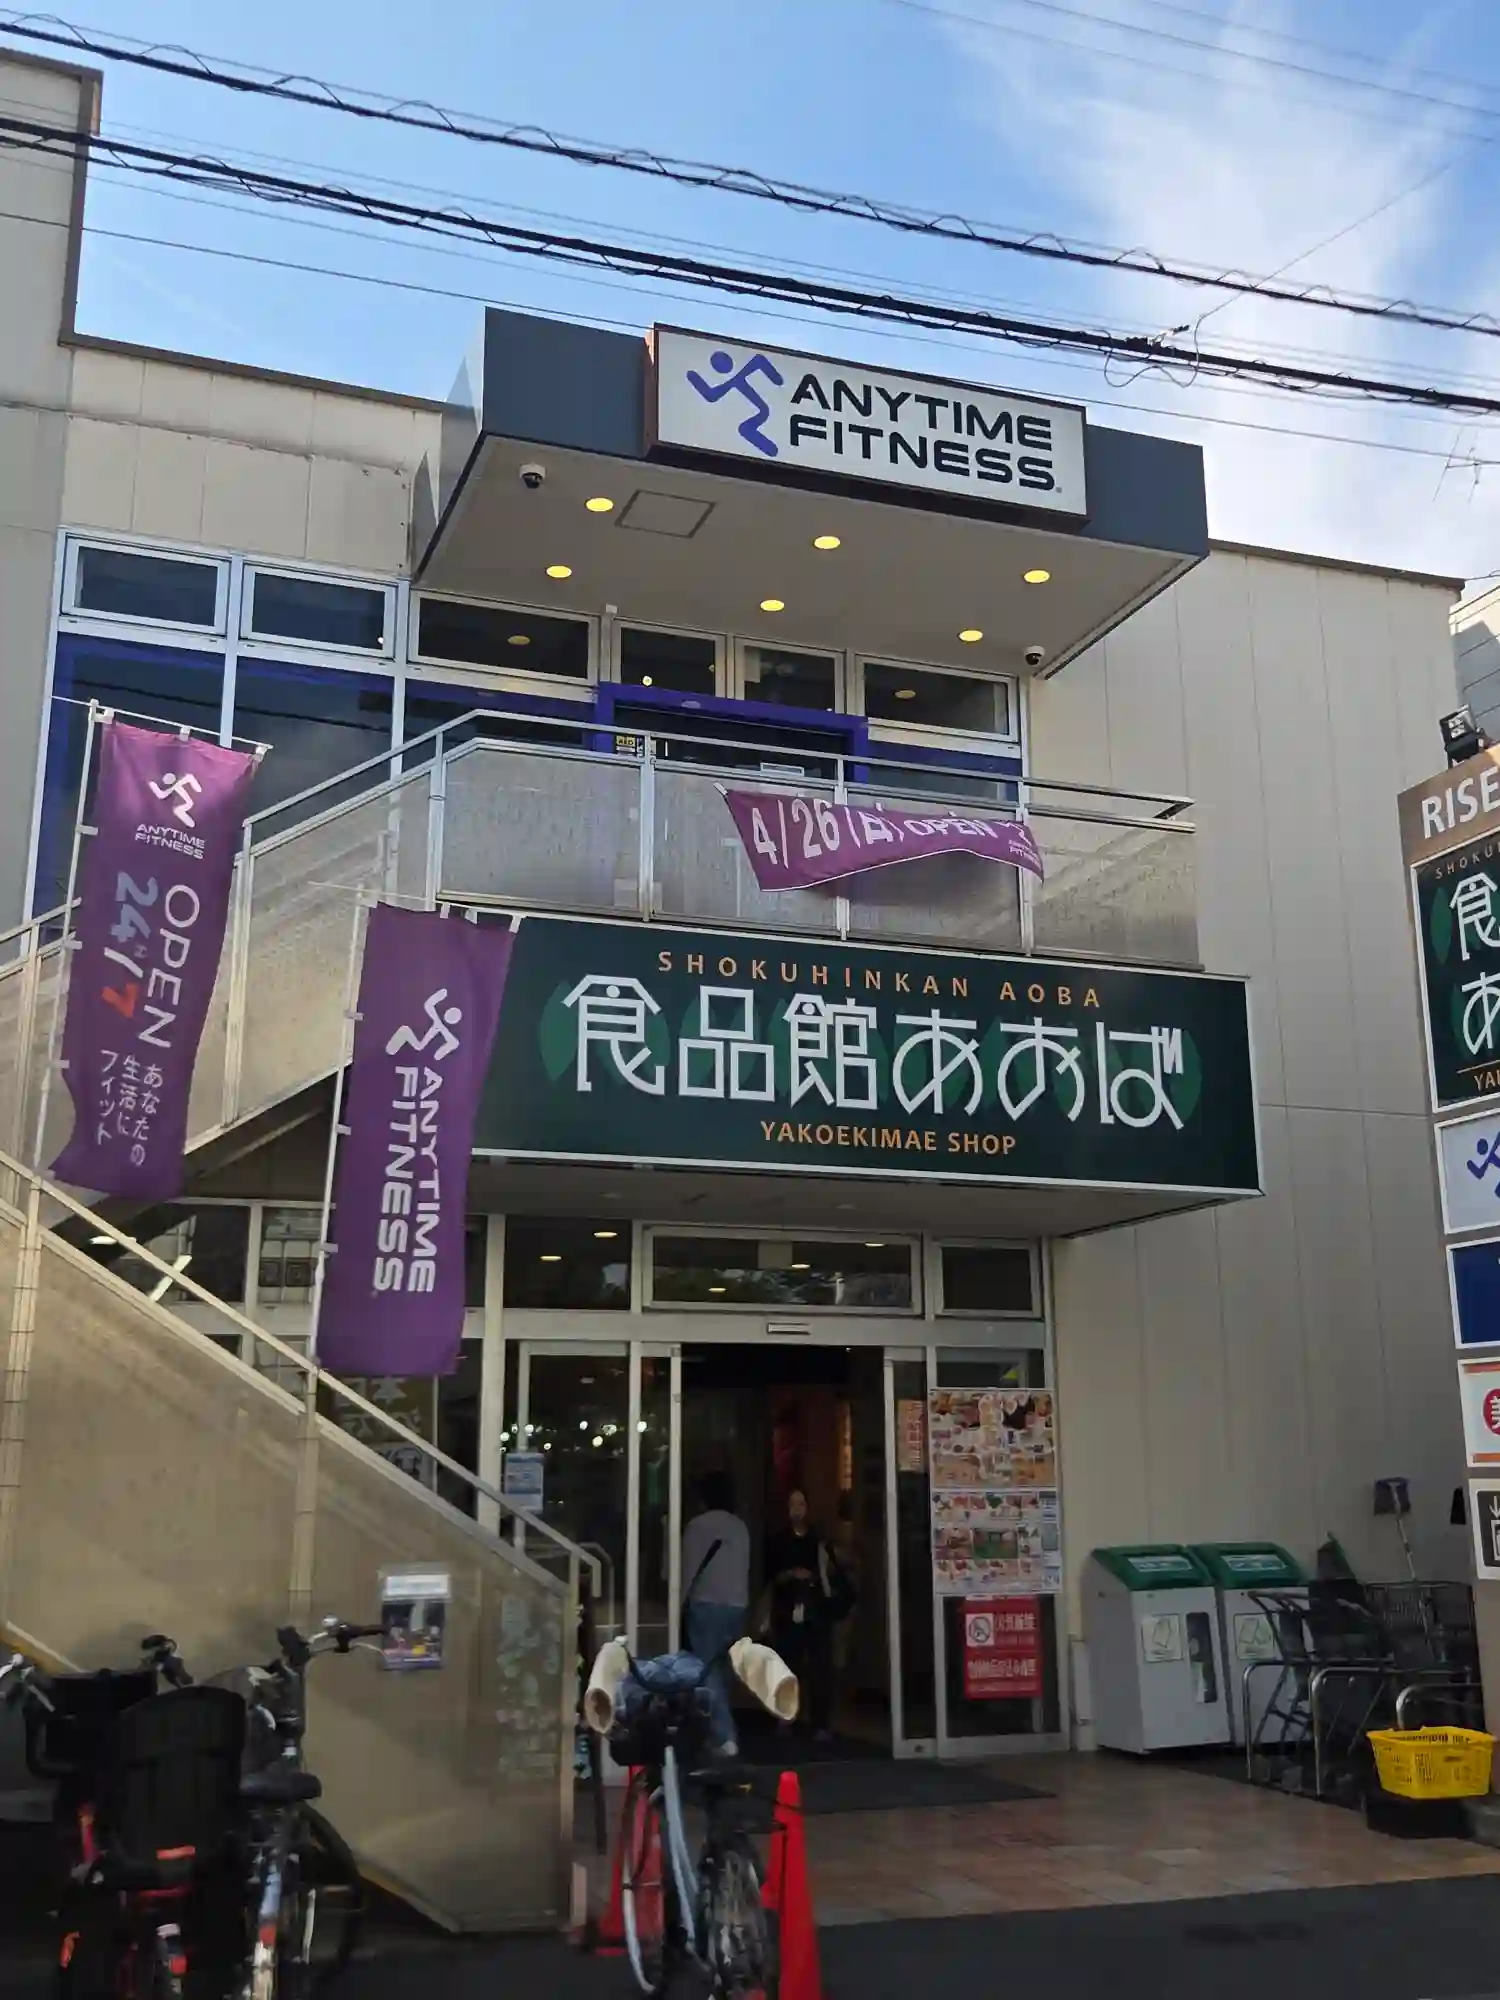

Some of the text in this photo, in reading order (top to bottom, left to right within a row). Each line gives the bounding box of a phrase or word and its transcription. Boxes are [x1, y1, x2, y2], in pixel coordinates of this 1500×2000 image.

[790, 373, 1053, 451] ANYTIME
[790, 414, 1056, 492] FITNESS
[136, 823, 206, 849] ANYTIME
[1421, 766, 1500, 839] RISE
[134, 832, 204, 860] FITNESS
[1435, 845, 1500, 880] SHOKU
[138, 884, 200, 1048] OPEN
[657, 950, 1102, 1009] SHOKUHINKAN AOBA
[562, 973, 1186, 1132] 食品館あおば
[97, 1049, 119, 1146] フィット
[117, 1053, 141, 1136] 生活に
[129, 1063, 165, 1167] あなたの
[759, 1120, 1017, 1158] YAKOEKIMAE SHOP
[373, 1065, 419, 1293] FITNESS
[407, 1066, 443, 1293] ANYTIME
